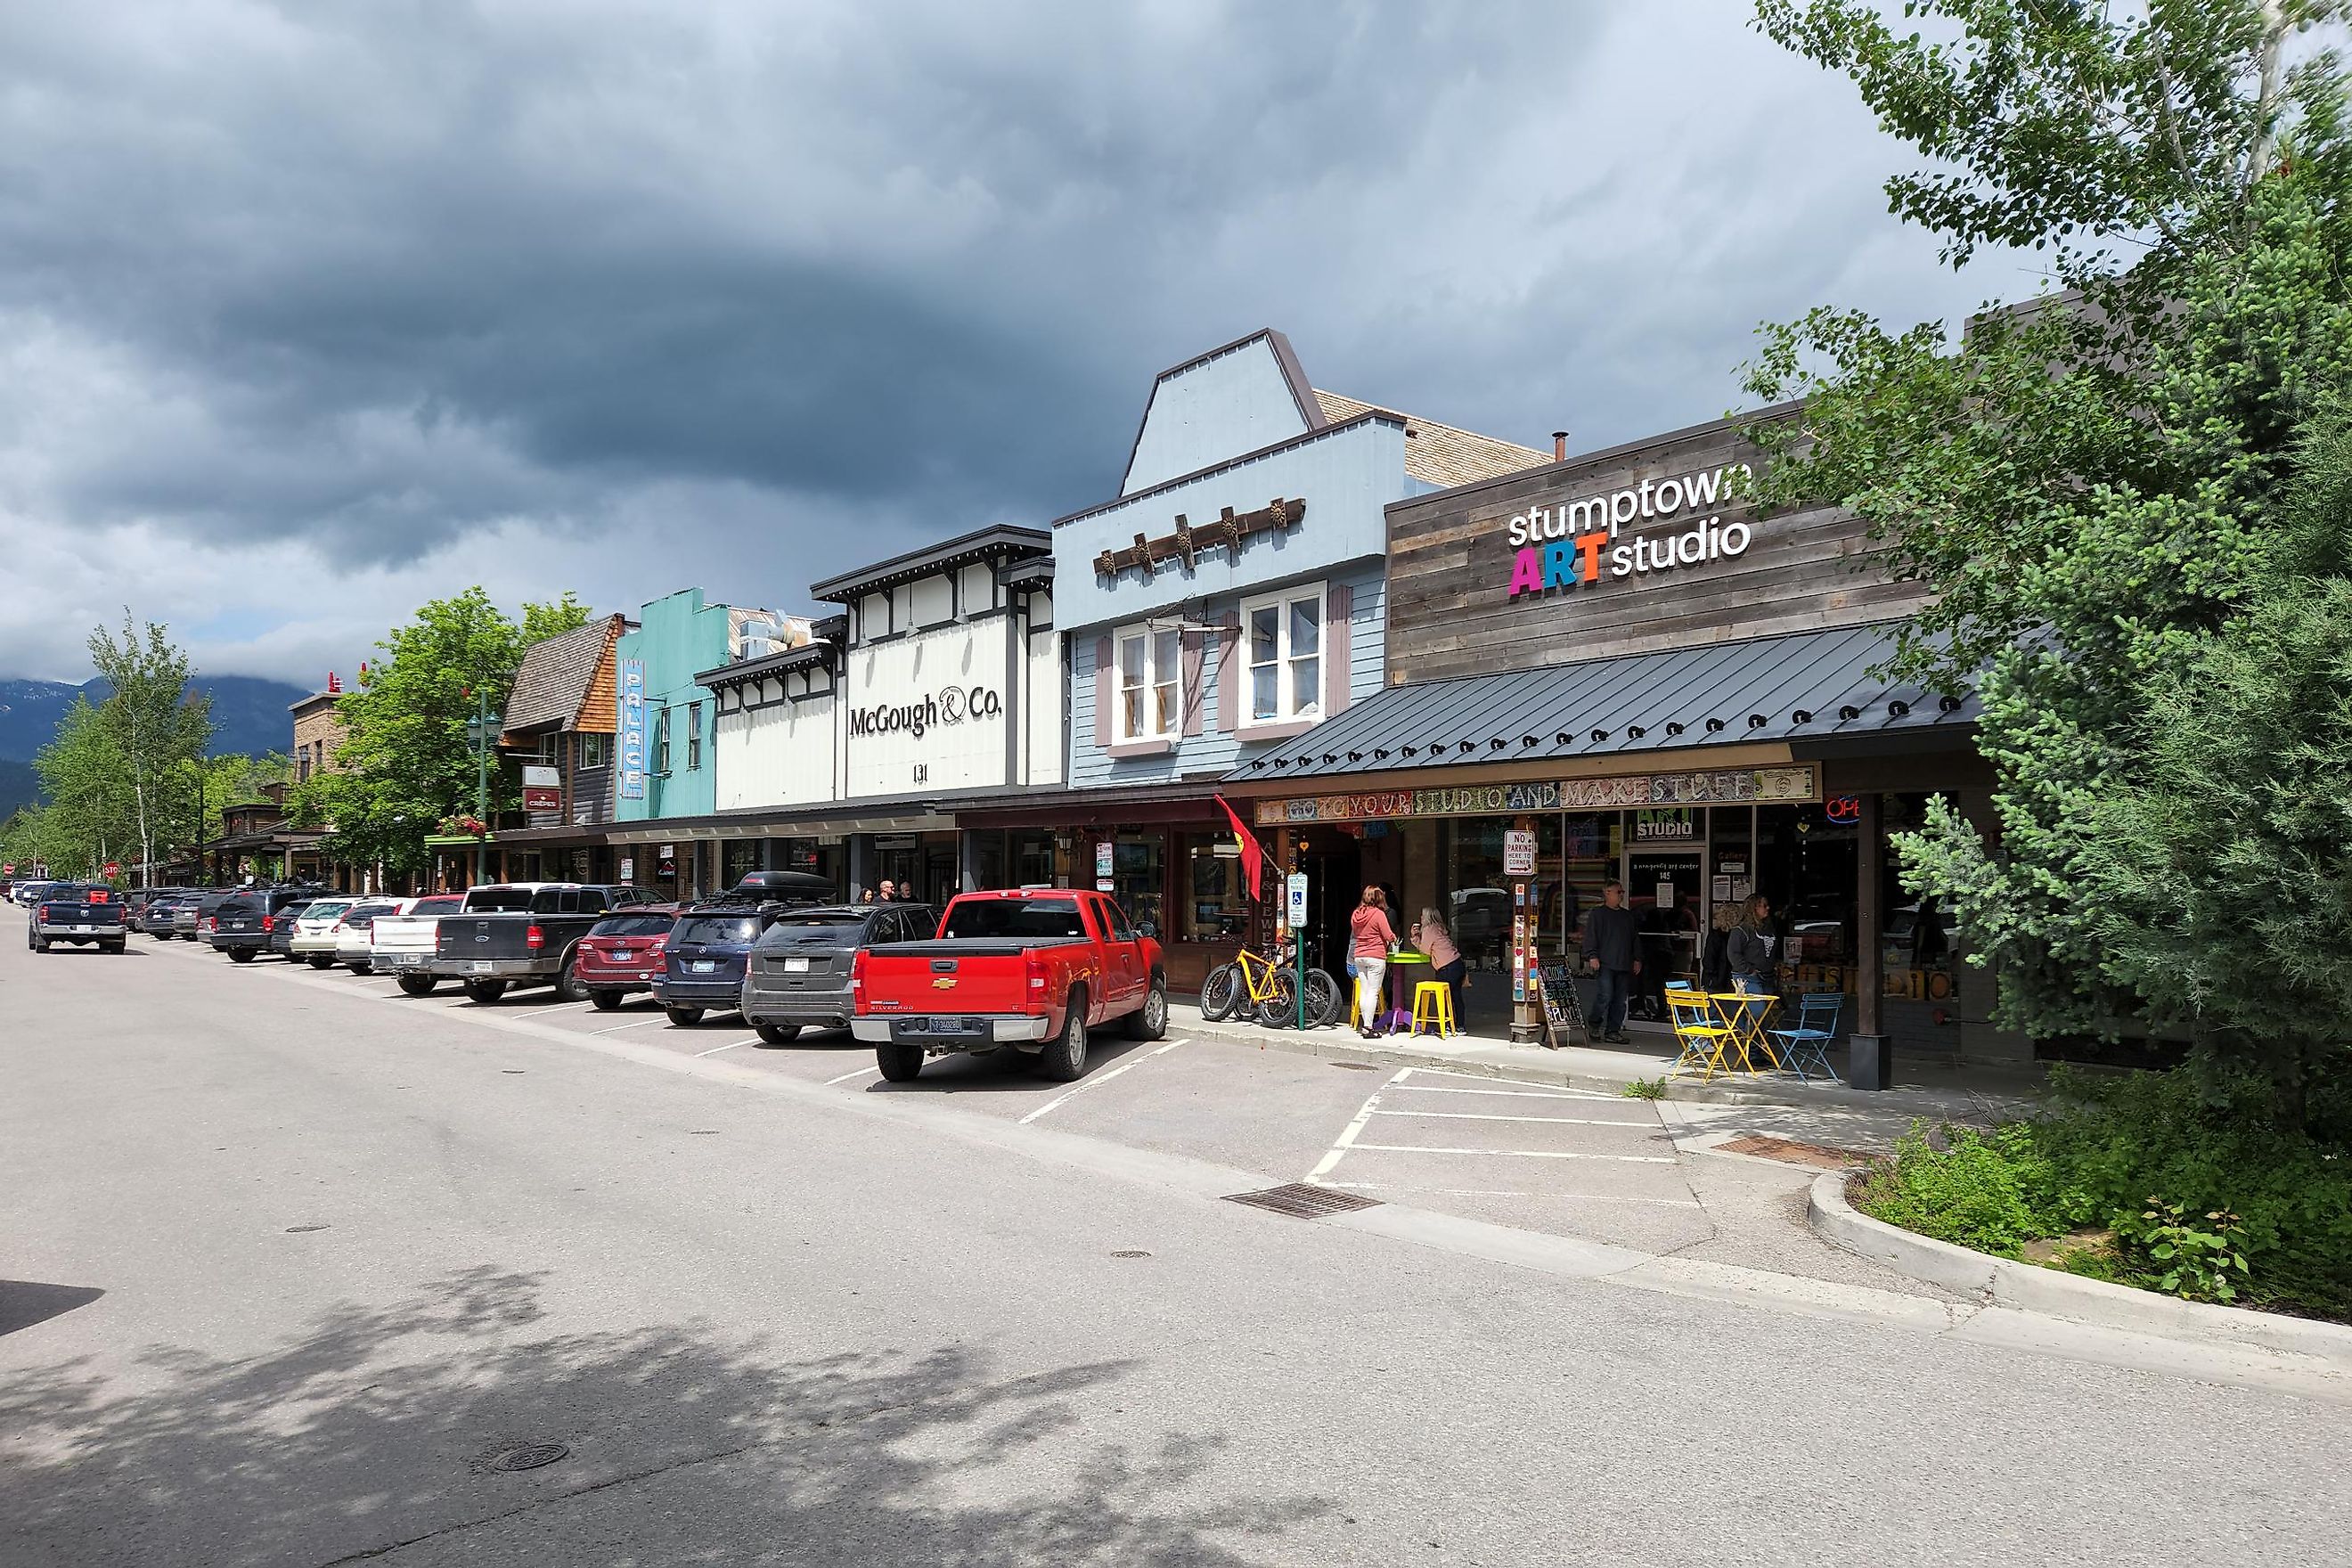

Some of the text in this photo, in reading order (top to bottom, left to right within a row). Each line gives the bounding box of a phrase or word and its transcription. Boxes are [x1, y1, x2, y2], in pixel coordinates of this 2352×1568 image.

[1508, 463, 1752, 546] stumptown
[1507, 517, 1752, 596] ART studio
[625, 672, 641, 786] PALACE
[850, 693, 937, 738] McGough
[969, 686, 1002, 717] Co.
[913, 764, 928, 784] 131
[1350, 791, 1410, 814] YOUR
[1415, 788, 1503, 813] STUDIO
[1511, 783, 1556, 808] AND
[1566, 779, 1648, 805] MAKE
[1826, 799, 1860, 817] OPE
[1515, 834, 1525, 843] NO
[1637, 821, 1693, 836] STUDIO
[1262, 841, 1275, 878] AT
[1660, 871, 1671, 880] 145
